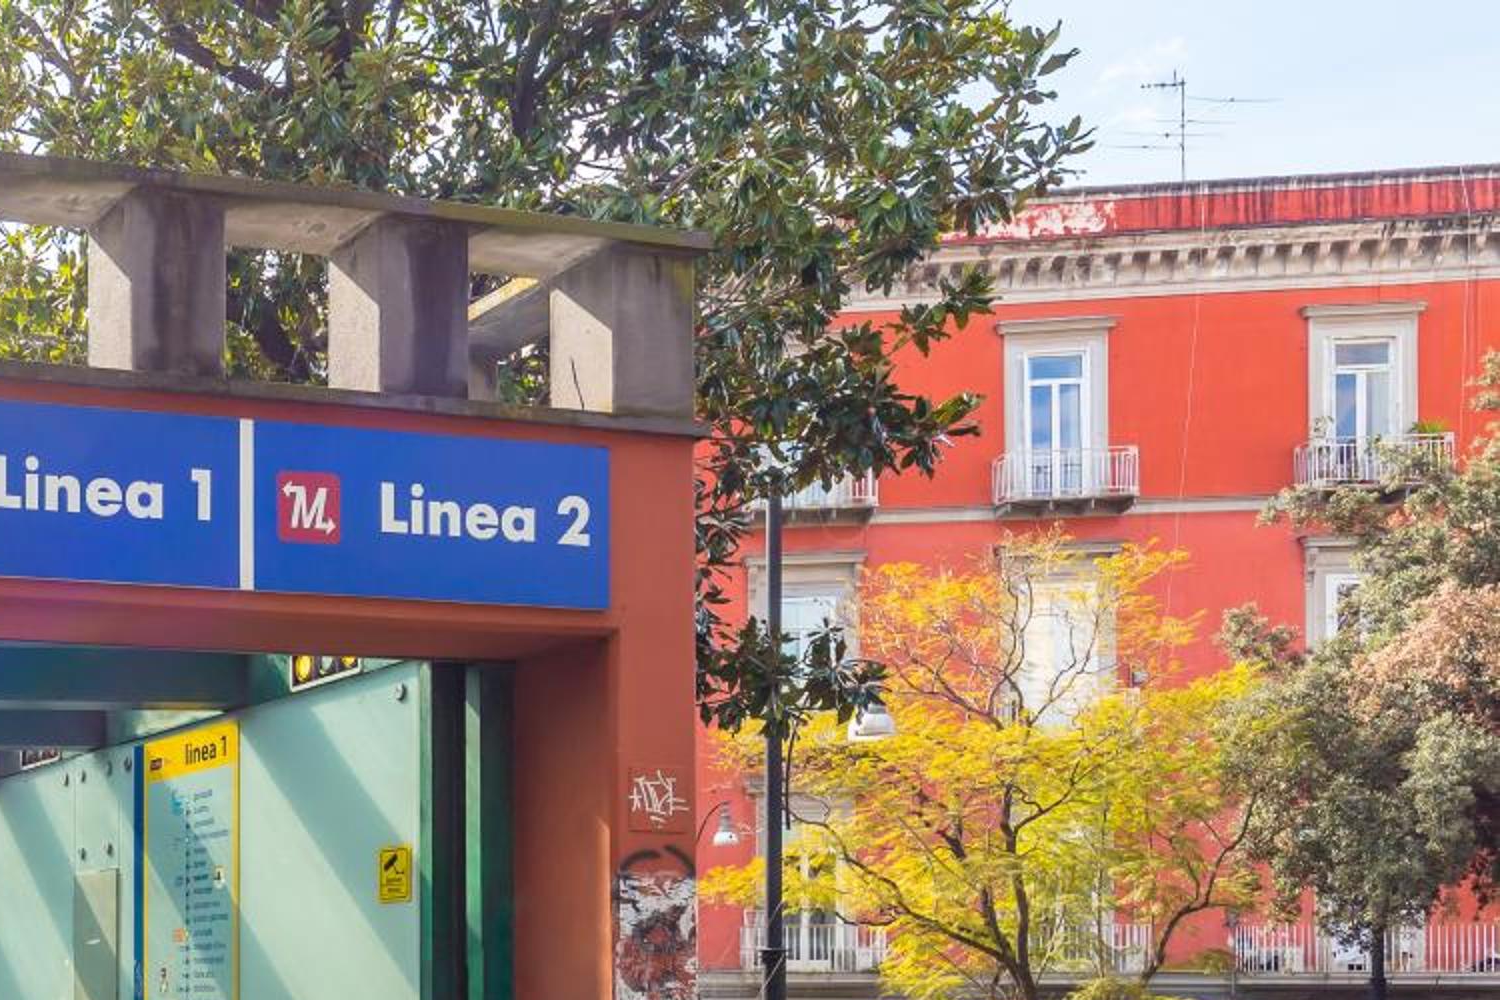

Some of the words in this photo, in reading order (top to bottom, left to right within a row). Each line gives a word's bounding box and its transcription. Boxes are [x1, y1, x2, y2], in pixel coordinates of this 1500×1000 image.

[191, 468, 212, 521] 1
[380, 482, 536, 543] Linea
[556, 495, 591, 547] 2
[185, 742, 217, 765] linea
[219, 736, 227, 757] 1
